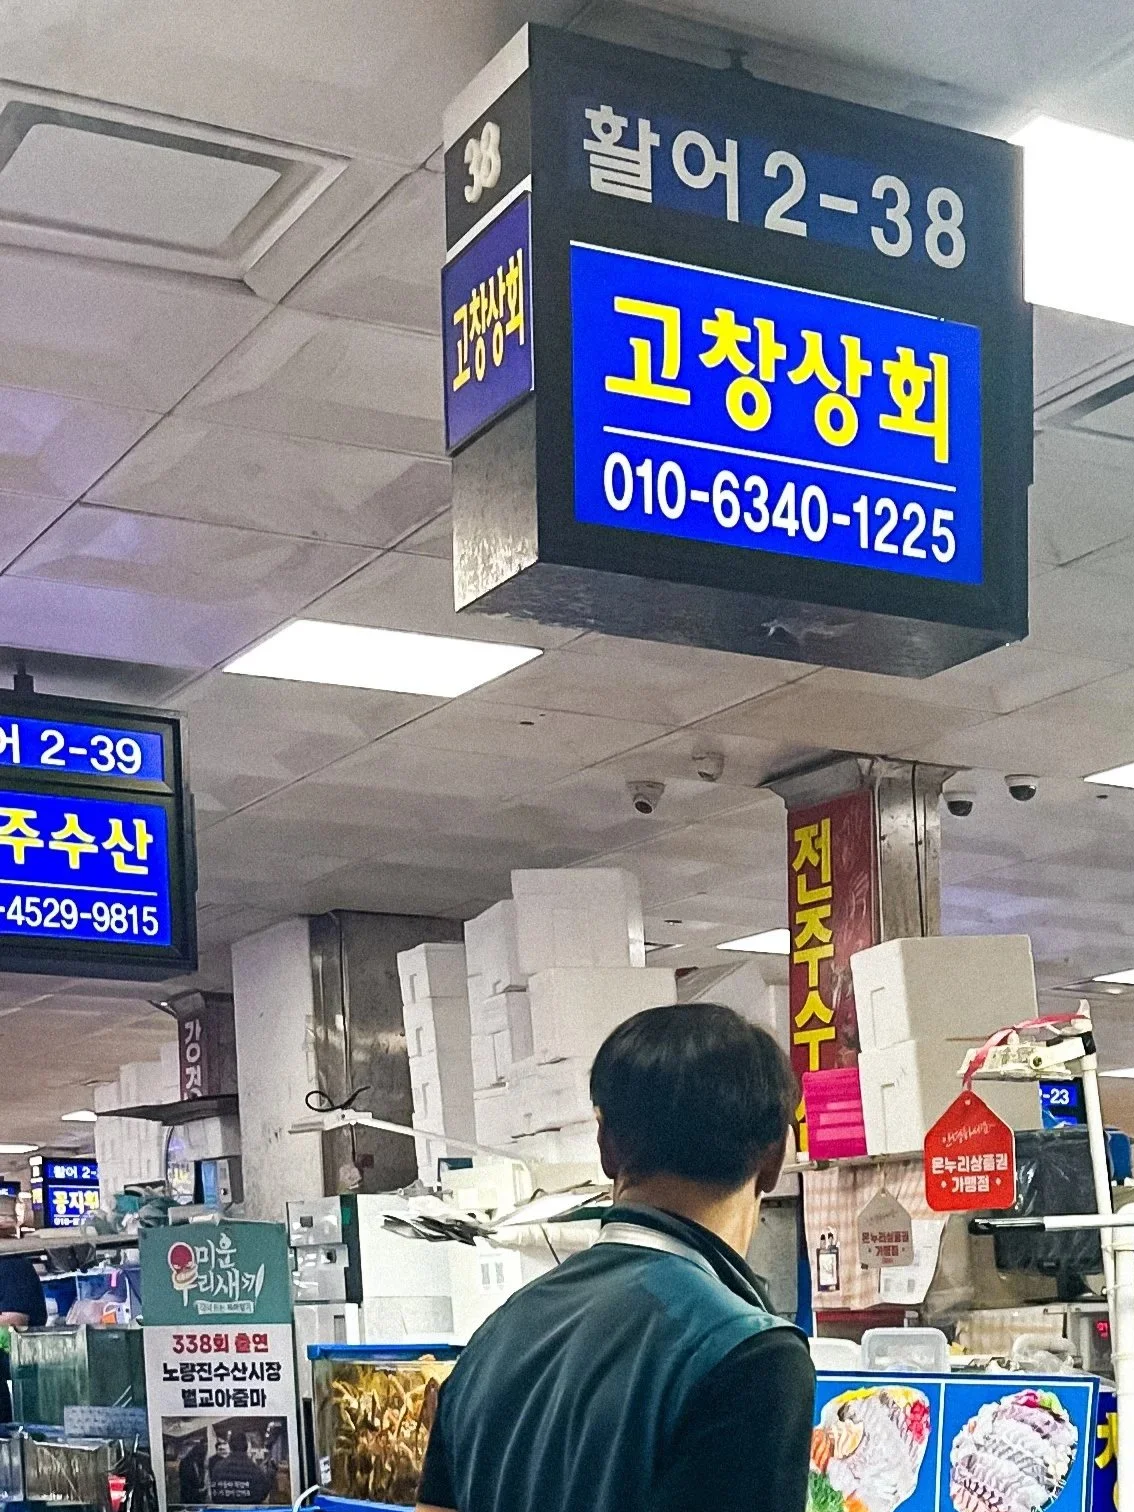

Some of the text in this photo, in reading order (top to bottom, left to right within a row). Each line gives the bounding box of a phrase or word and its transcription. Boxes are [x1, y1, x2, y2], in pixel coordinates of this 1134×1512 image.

[464, 121, 501, 203] 38
[583, 105, 966, 268] 활어 2-38
[453, 248, 524, 392] 고창상회
[604, 295, 948, 464] 고창상회
[603, 451, 956, 563] 010-6340-1225
[41, 729, 142, 774] 2-39
[0, 807, 154, 875] 주수산
[793, 817, 836, 1154] 전주수
[1039, 1088, 1069, 1104] -23
[931, 1153, 1008, 1175] 온누리상품권
[952, 1175, 990, 1192] 가맹점
[163, 1362, 282, 1382] 노량진수산시장
[172, 1333, 229, 1354] 338회
